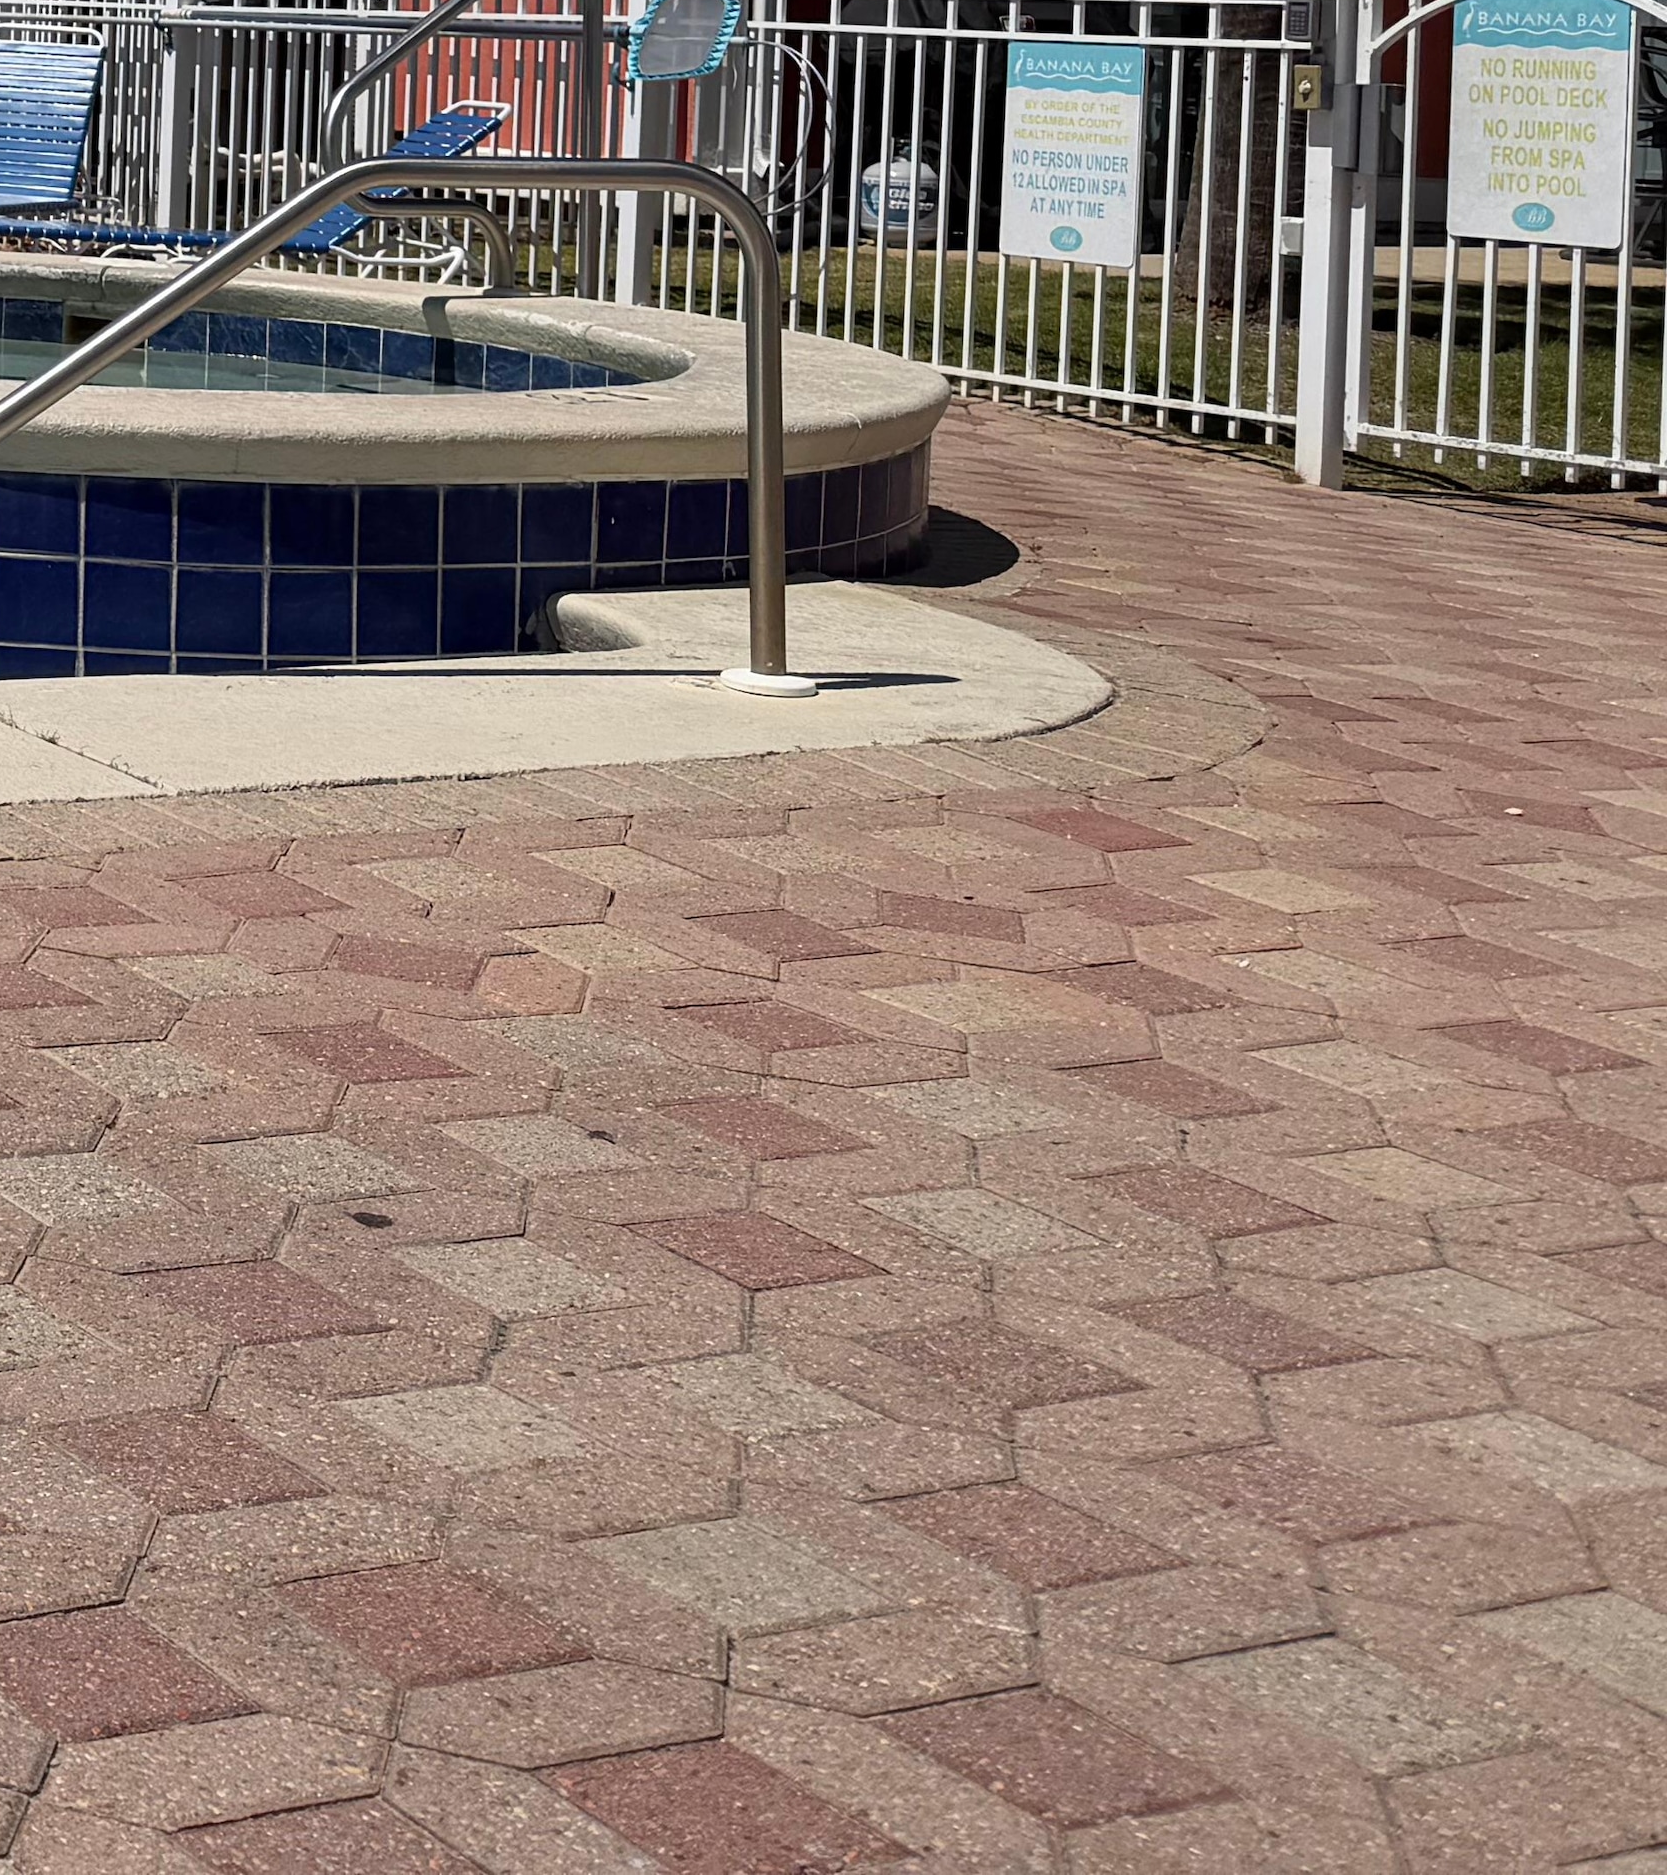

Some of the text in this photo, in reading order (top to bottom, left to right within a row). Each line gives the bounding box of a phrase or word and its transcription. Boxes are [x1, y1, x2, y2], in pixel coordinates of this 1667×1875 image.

[1478, 12, 1616, 28] BANANA BAY
[1026, 59, 1133, 75] BANANA BAY
[1480, 58, 1597, 81] NO RUNNING
[1025, 100, 1121, 115] BY ORDER OF THE
[1469, 84, 1608, 109] ON POOL DECK
[1021, 114, 1124, 130] ESCAMBIA COUNTY
[1483, 119, 1597, 143] NO JUMPING
[1014, 128, 1130, 146] HEALTH DEPARTMENT
[1012, 149, 1129, 174] NO PERSON UNDER
[1491, 145, 1586, 170] FROM SPA
[1012, 173, 1127, 197] 12 ALLOWED IN SPA
[1488, 173, 1587, 197] INTO POOL
[1030, 197, 1105, 219] AT ANY TIME
